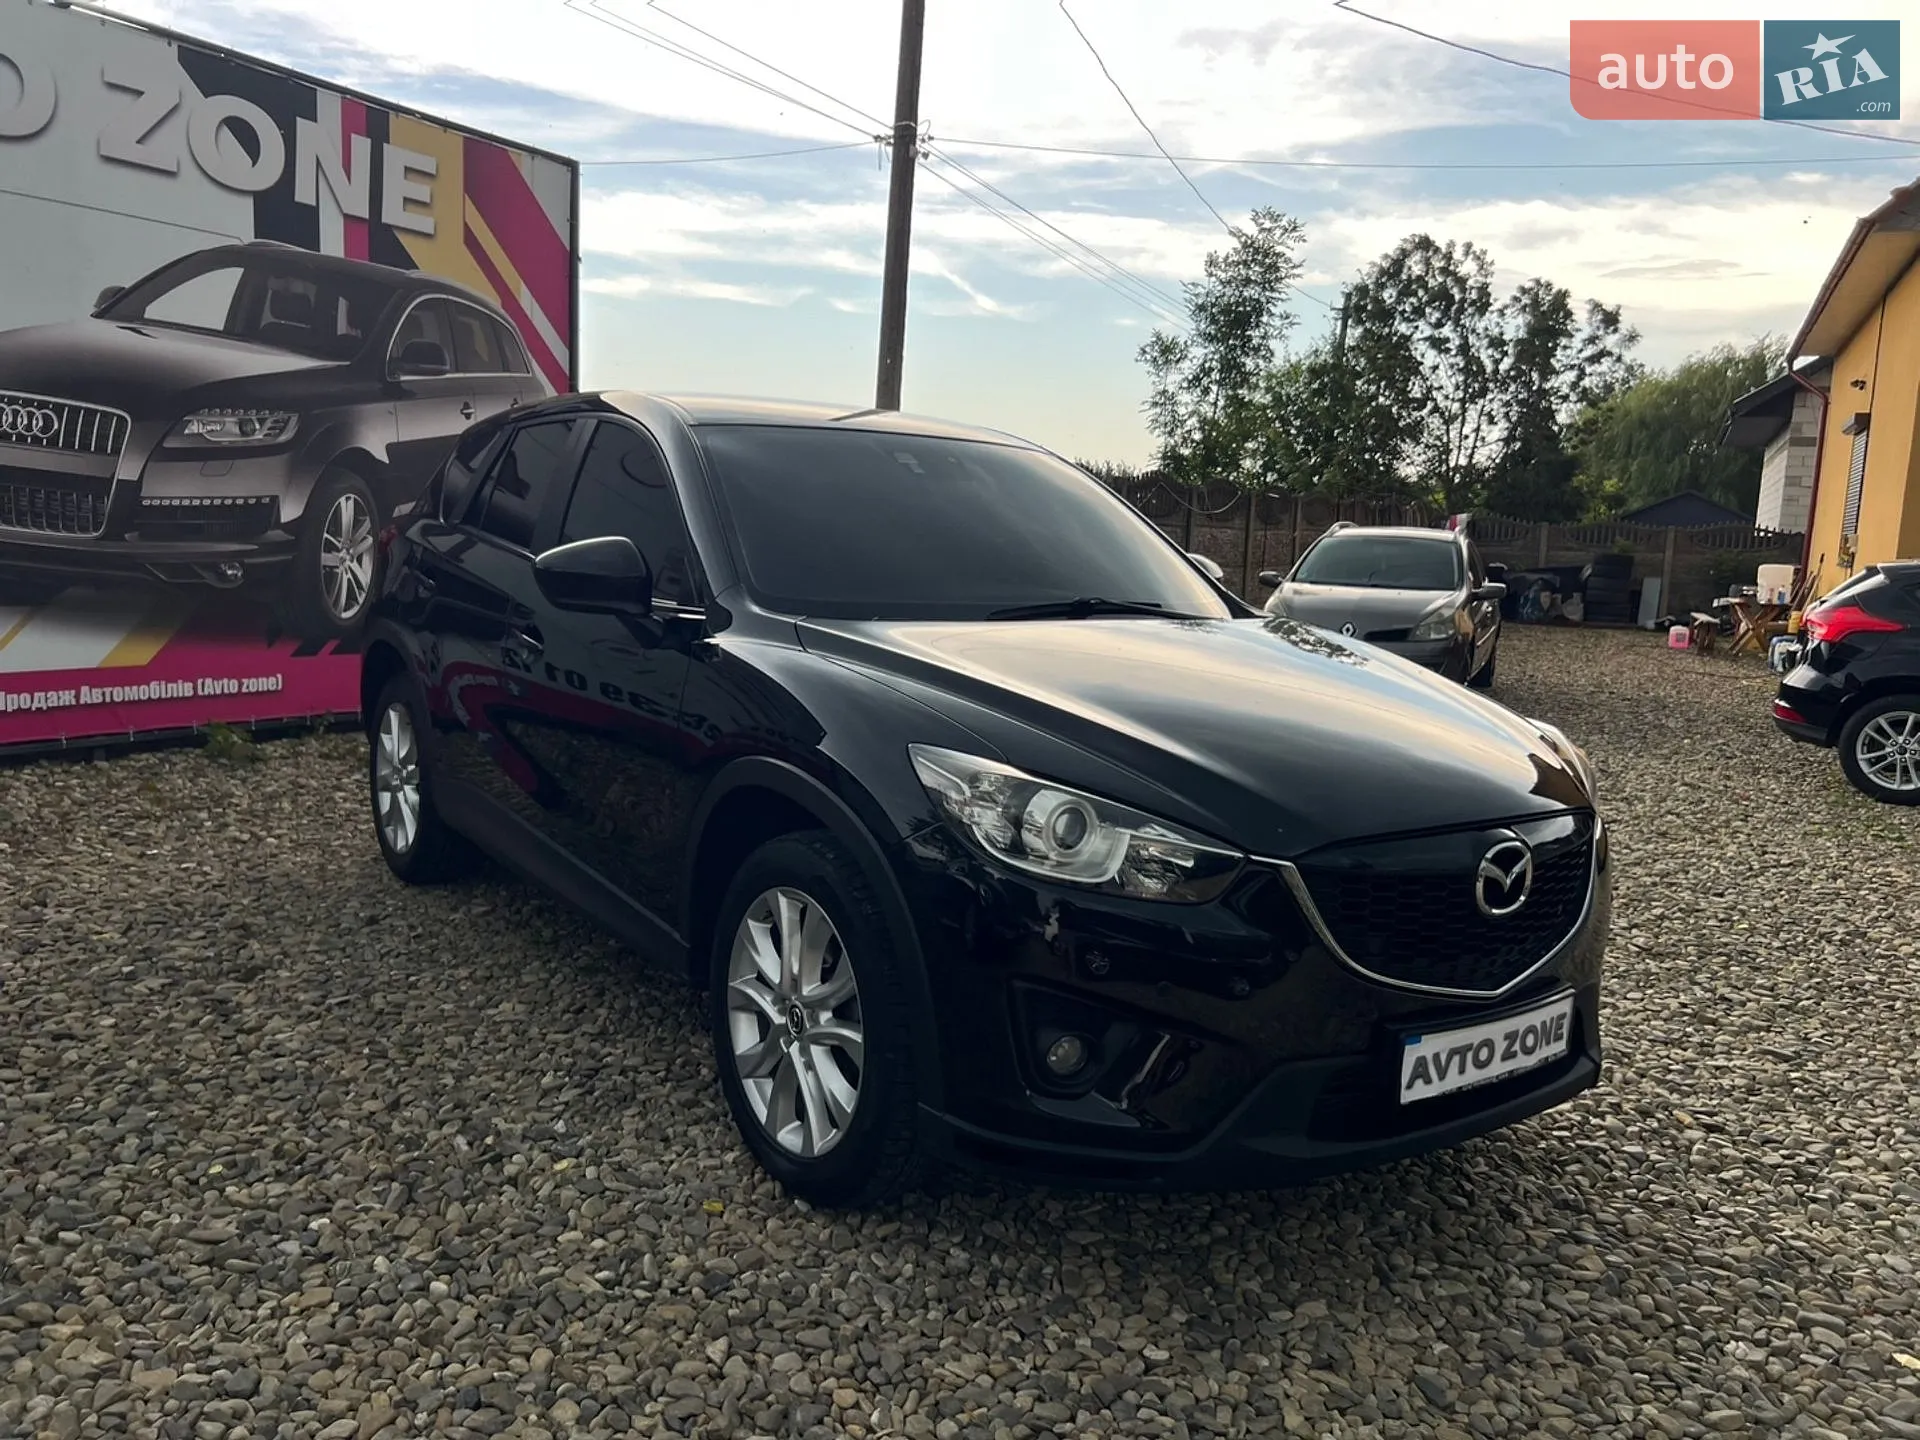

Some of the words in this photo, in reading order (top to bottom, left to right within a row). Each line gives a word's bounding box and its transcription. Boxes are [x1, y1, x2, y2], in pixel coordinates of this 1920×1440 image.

[98, 58, 437, 235] ZONE
[197, 677, 238, 696] (Avto
[241, 673, 282, 693] zone)
[1405, 1038, 1495, 1090] AVTO
[1500, 1012, 1567, 1062] ZONE
